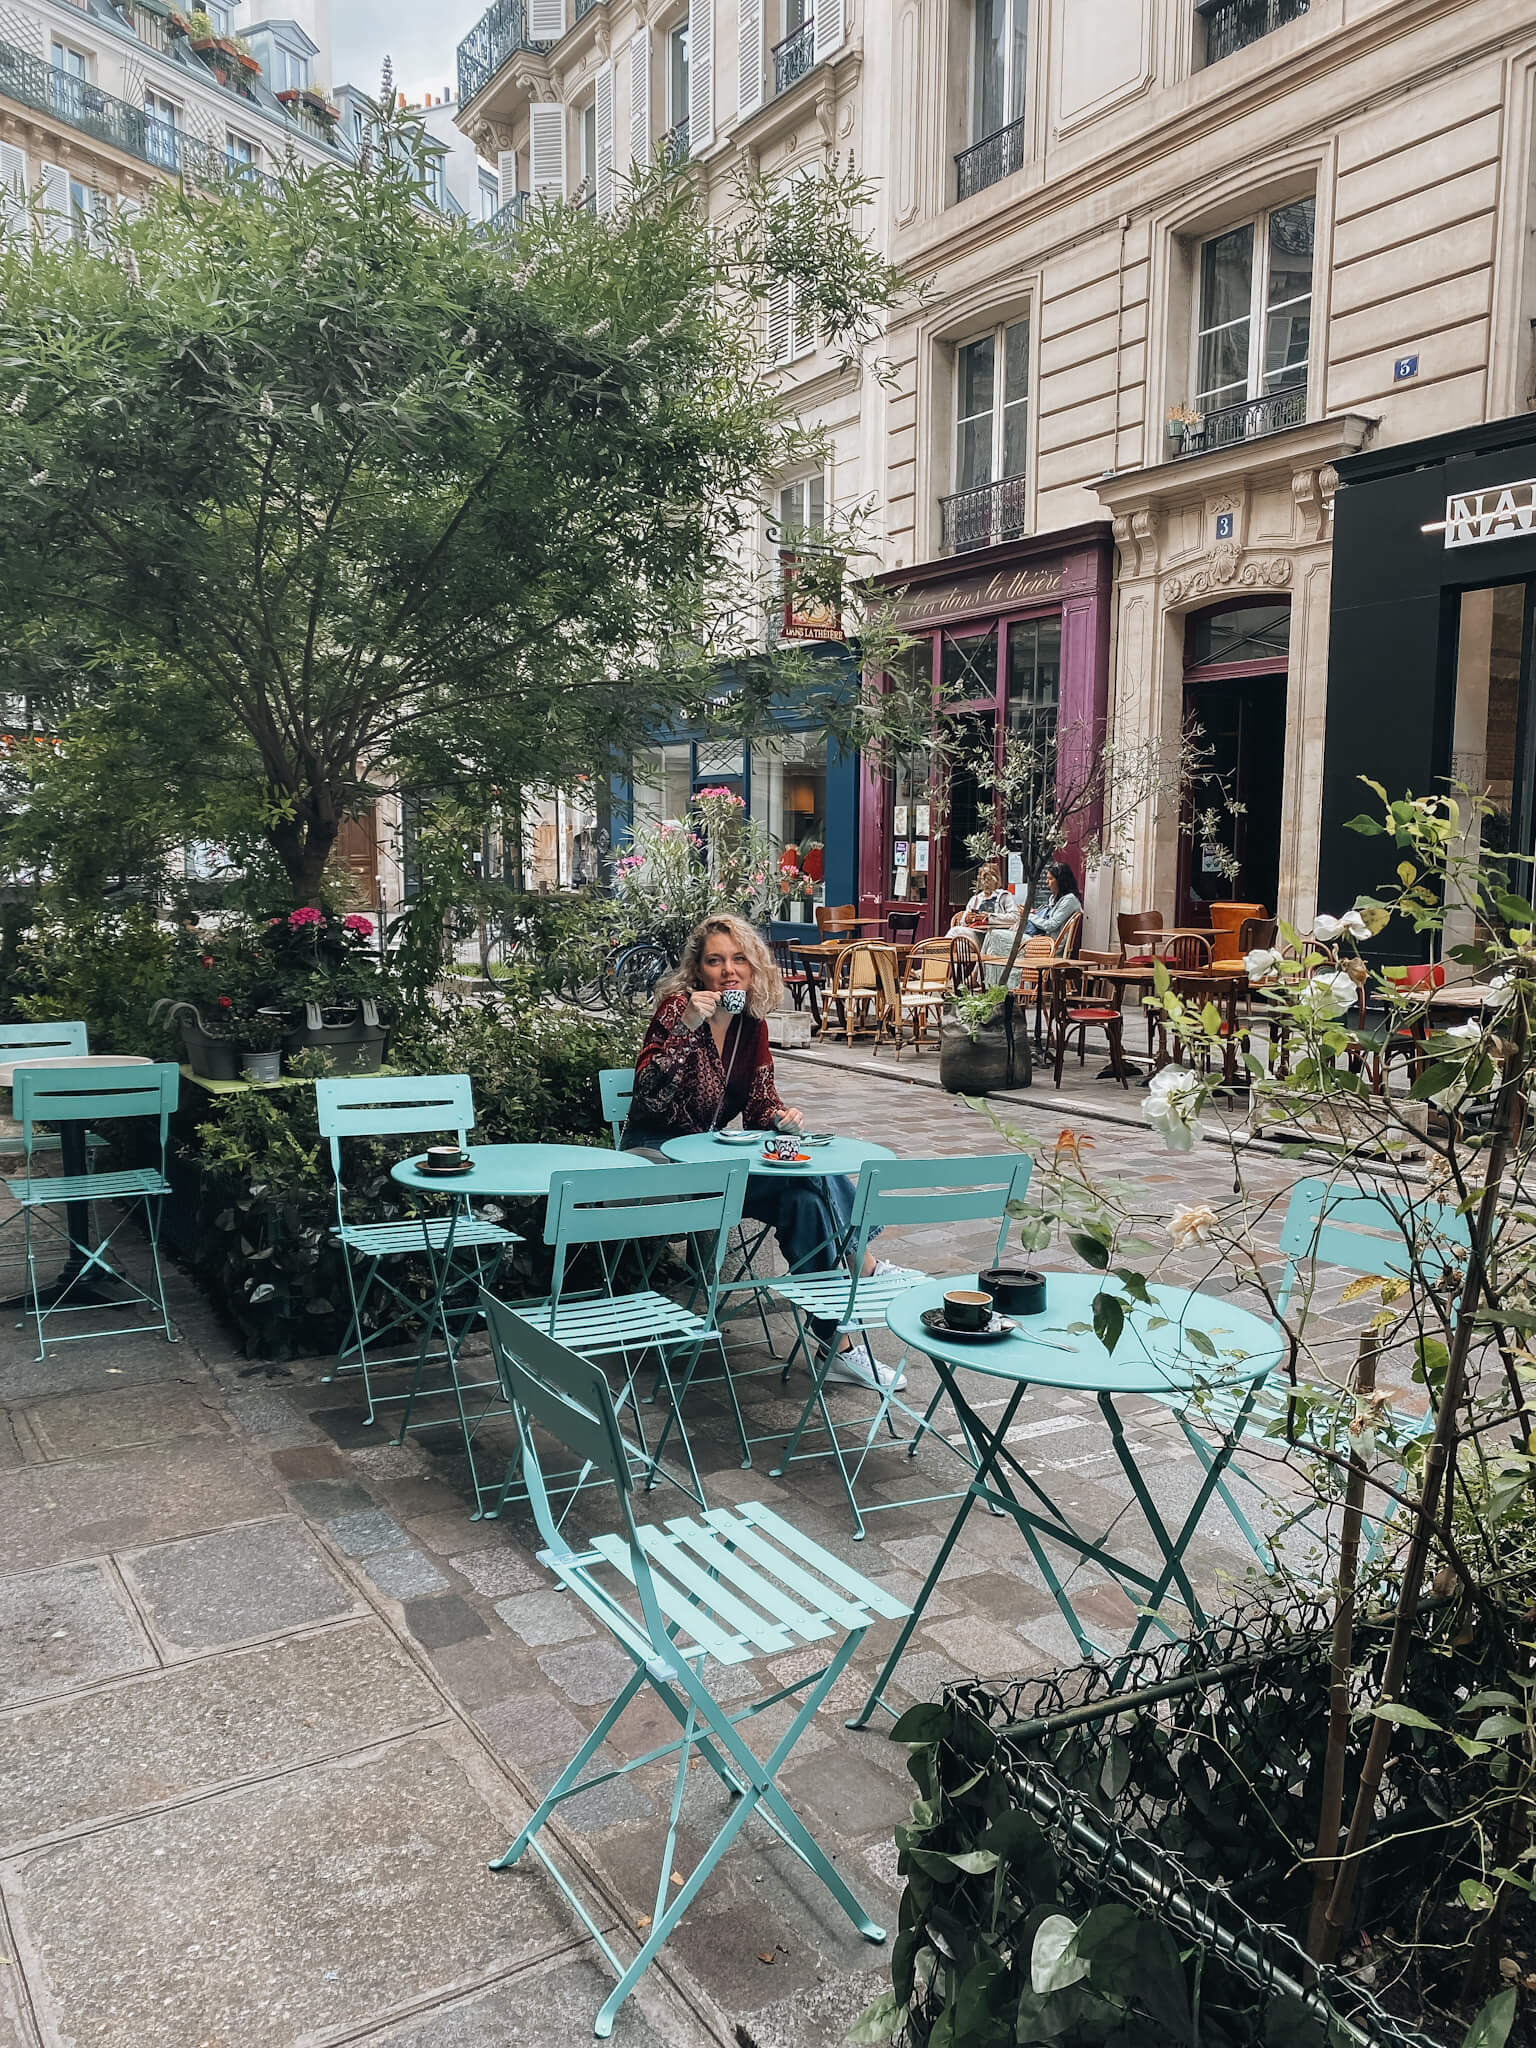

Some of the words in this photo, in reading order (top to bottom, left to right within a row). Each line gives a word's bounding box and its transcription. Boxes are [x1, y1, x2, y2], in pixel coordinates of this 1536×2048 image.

[1220, 517, 1229, 536] 3
[1451, 484, 1536, 542] NA
[939, 586, 981, 611] dans
[984, 571, 1003, 601] la
